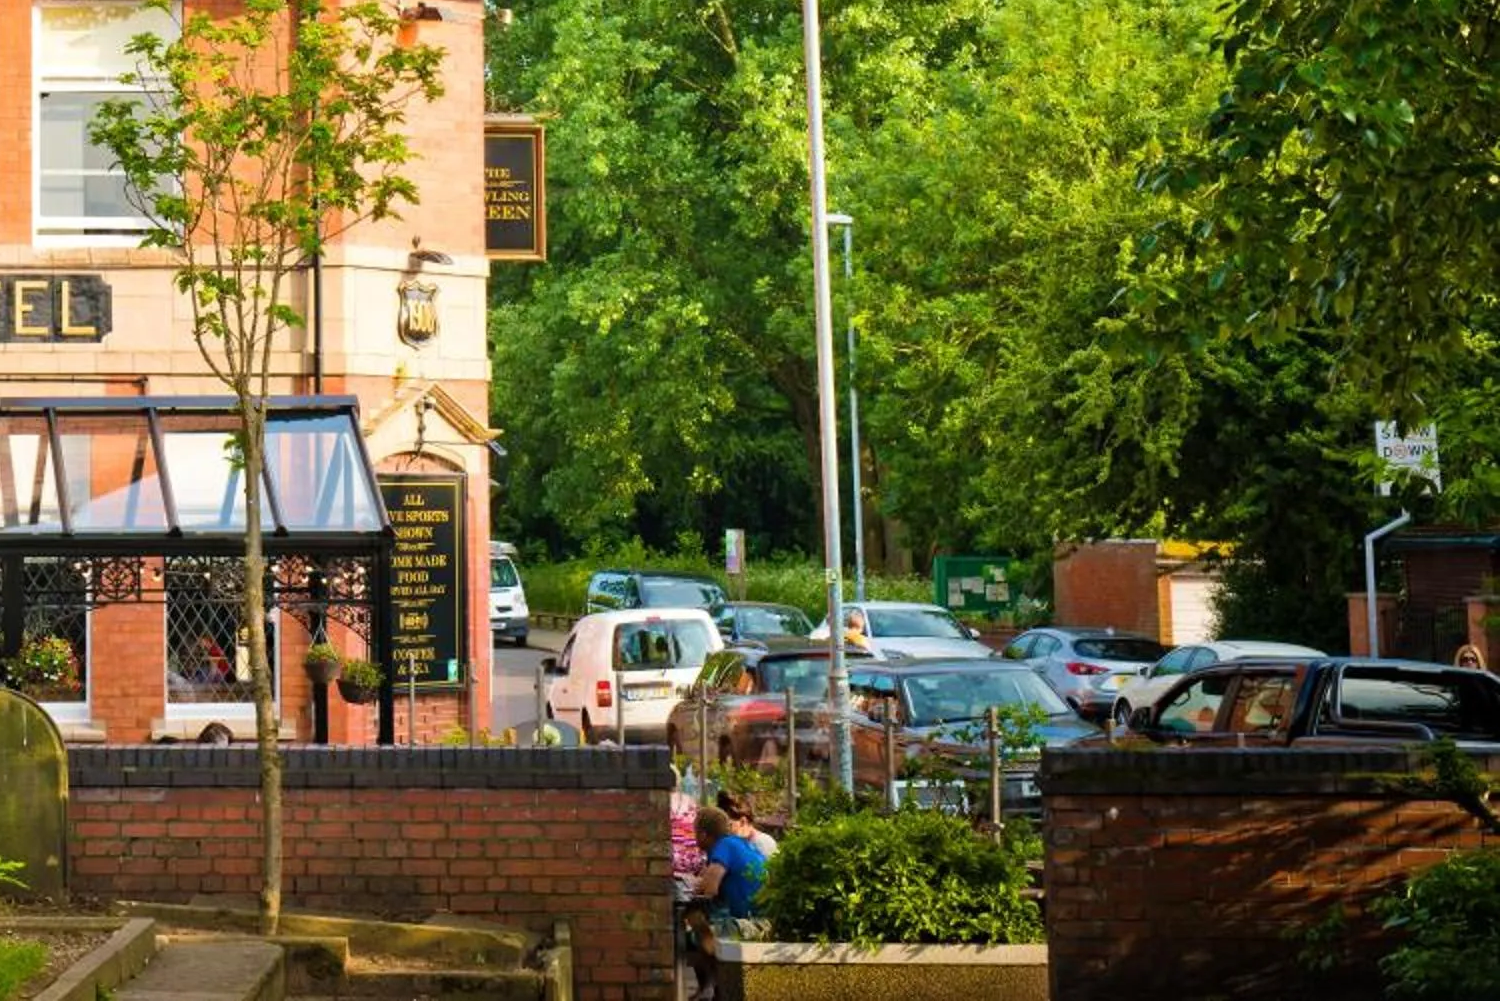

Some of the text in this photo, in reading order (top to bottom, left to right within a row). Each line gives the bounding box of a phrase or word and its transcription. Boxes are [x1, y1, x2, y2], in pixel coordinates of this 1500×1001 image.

[485, 206, 531, 220] EEN
[403, 494, 425, 506] ALL
[405, 510, 449, 522] SPORTS
[414, 554, 447, 567] MADE
[398, 570, 429, 583] FOOD
